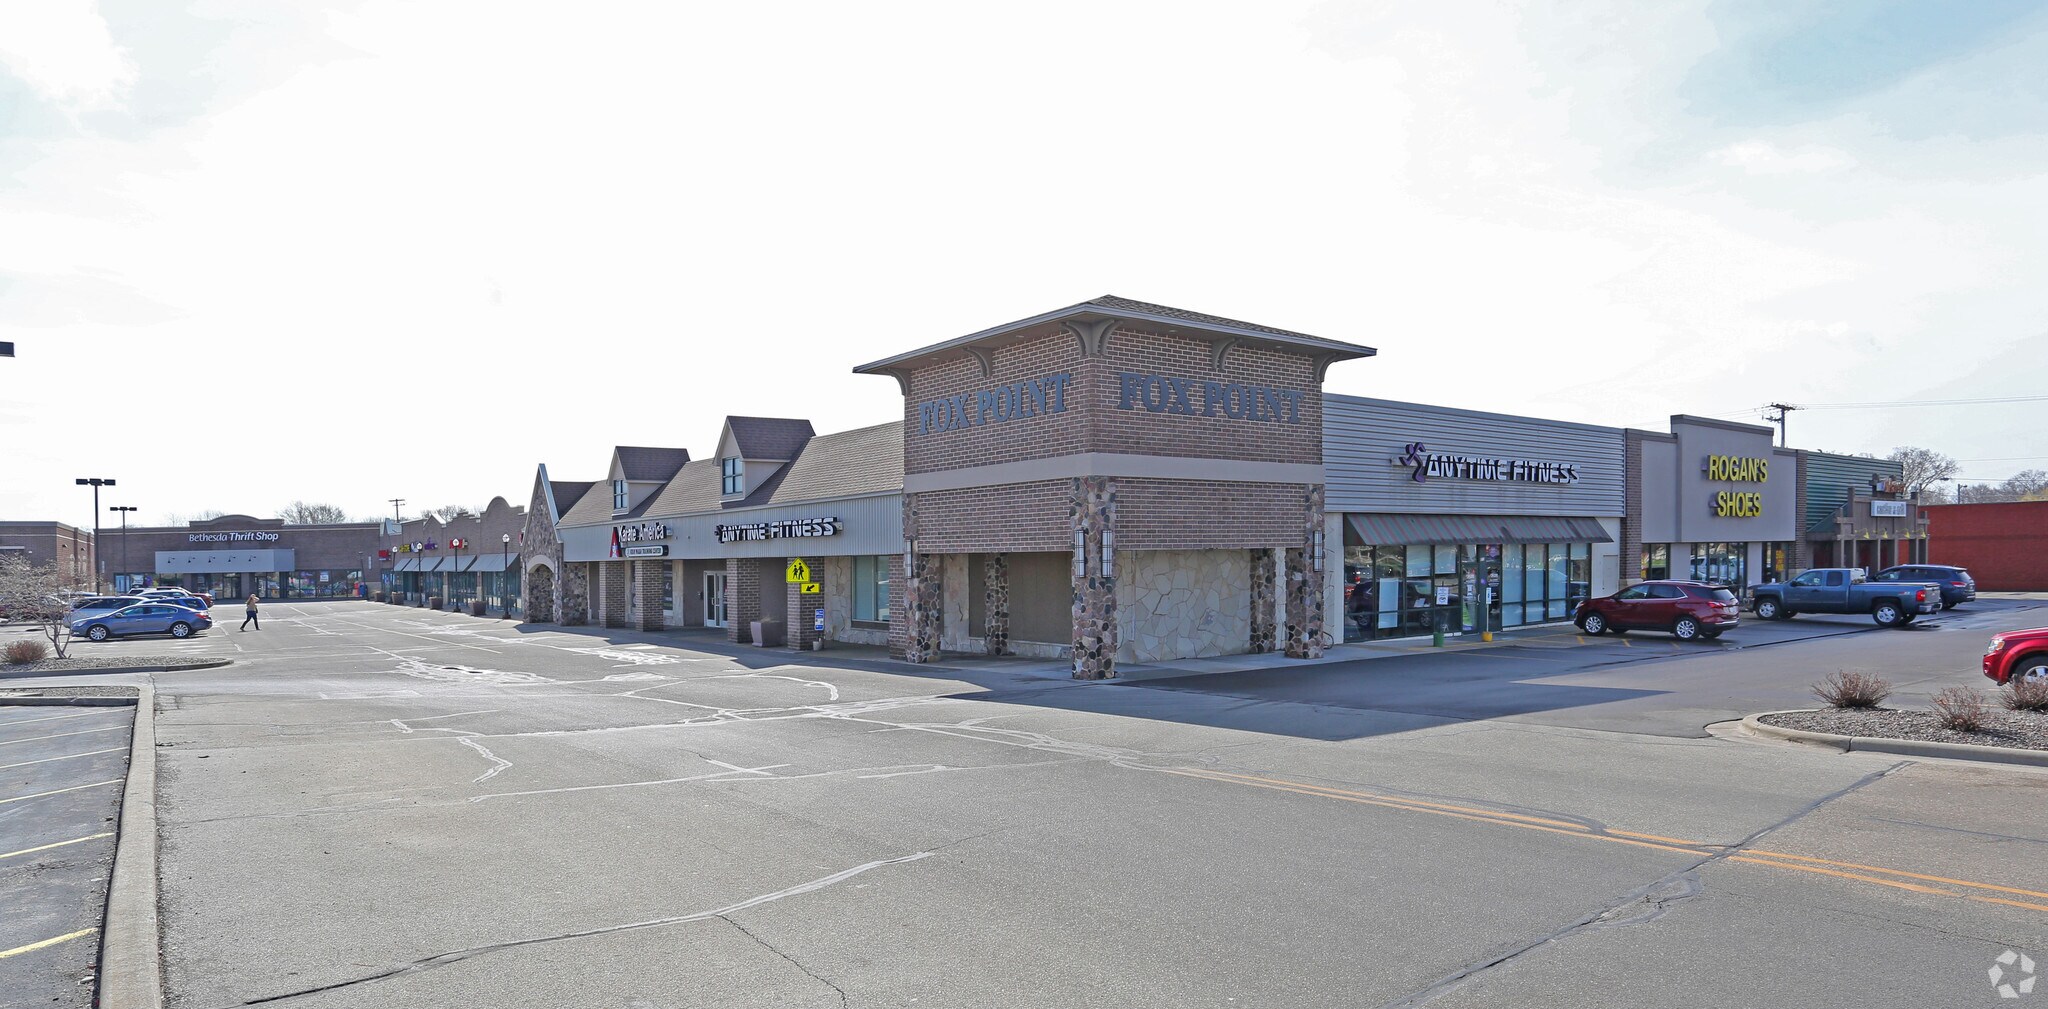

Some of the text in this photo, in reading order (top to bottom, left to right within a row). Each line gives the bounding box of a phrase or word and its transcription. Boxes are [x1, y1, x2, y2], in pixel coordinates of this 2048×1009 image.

[918, 373, 1070, 436] FOX POINT
[1118, 372, 1304, 424] FOX POINT
[1426, 454, 1581, 484] ANYTIME FITNESS
[1708, 455, 1768, 483] ROGAN'S
[1717, 491, 1761, 517] SHOES
[189, 531, 279, 542] Bethesda Thrift Shop
[619, 523, 664, 542] Karate America
[721, 517, 834, 542] ANYTIME FITNESS
